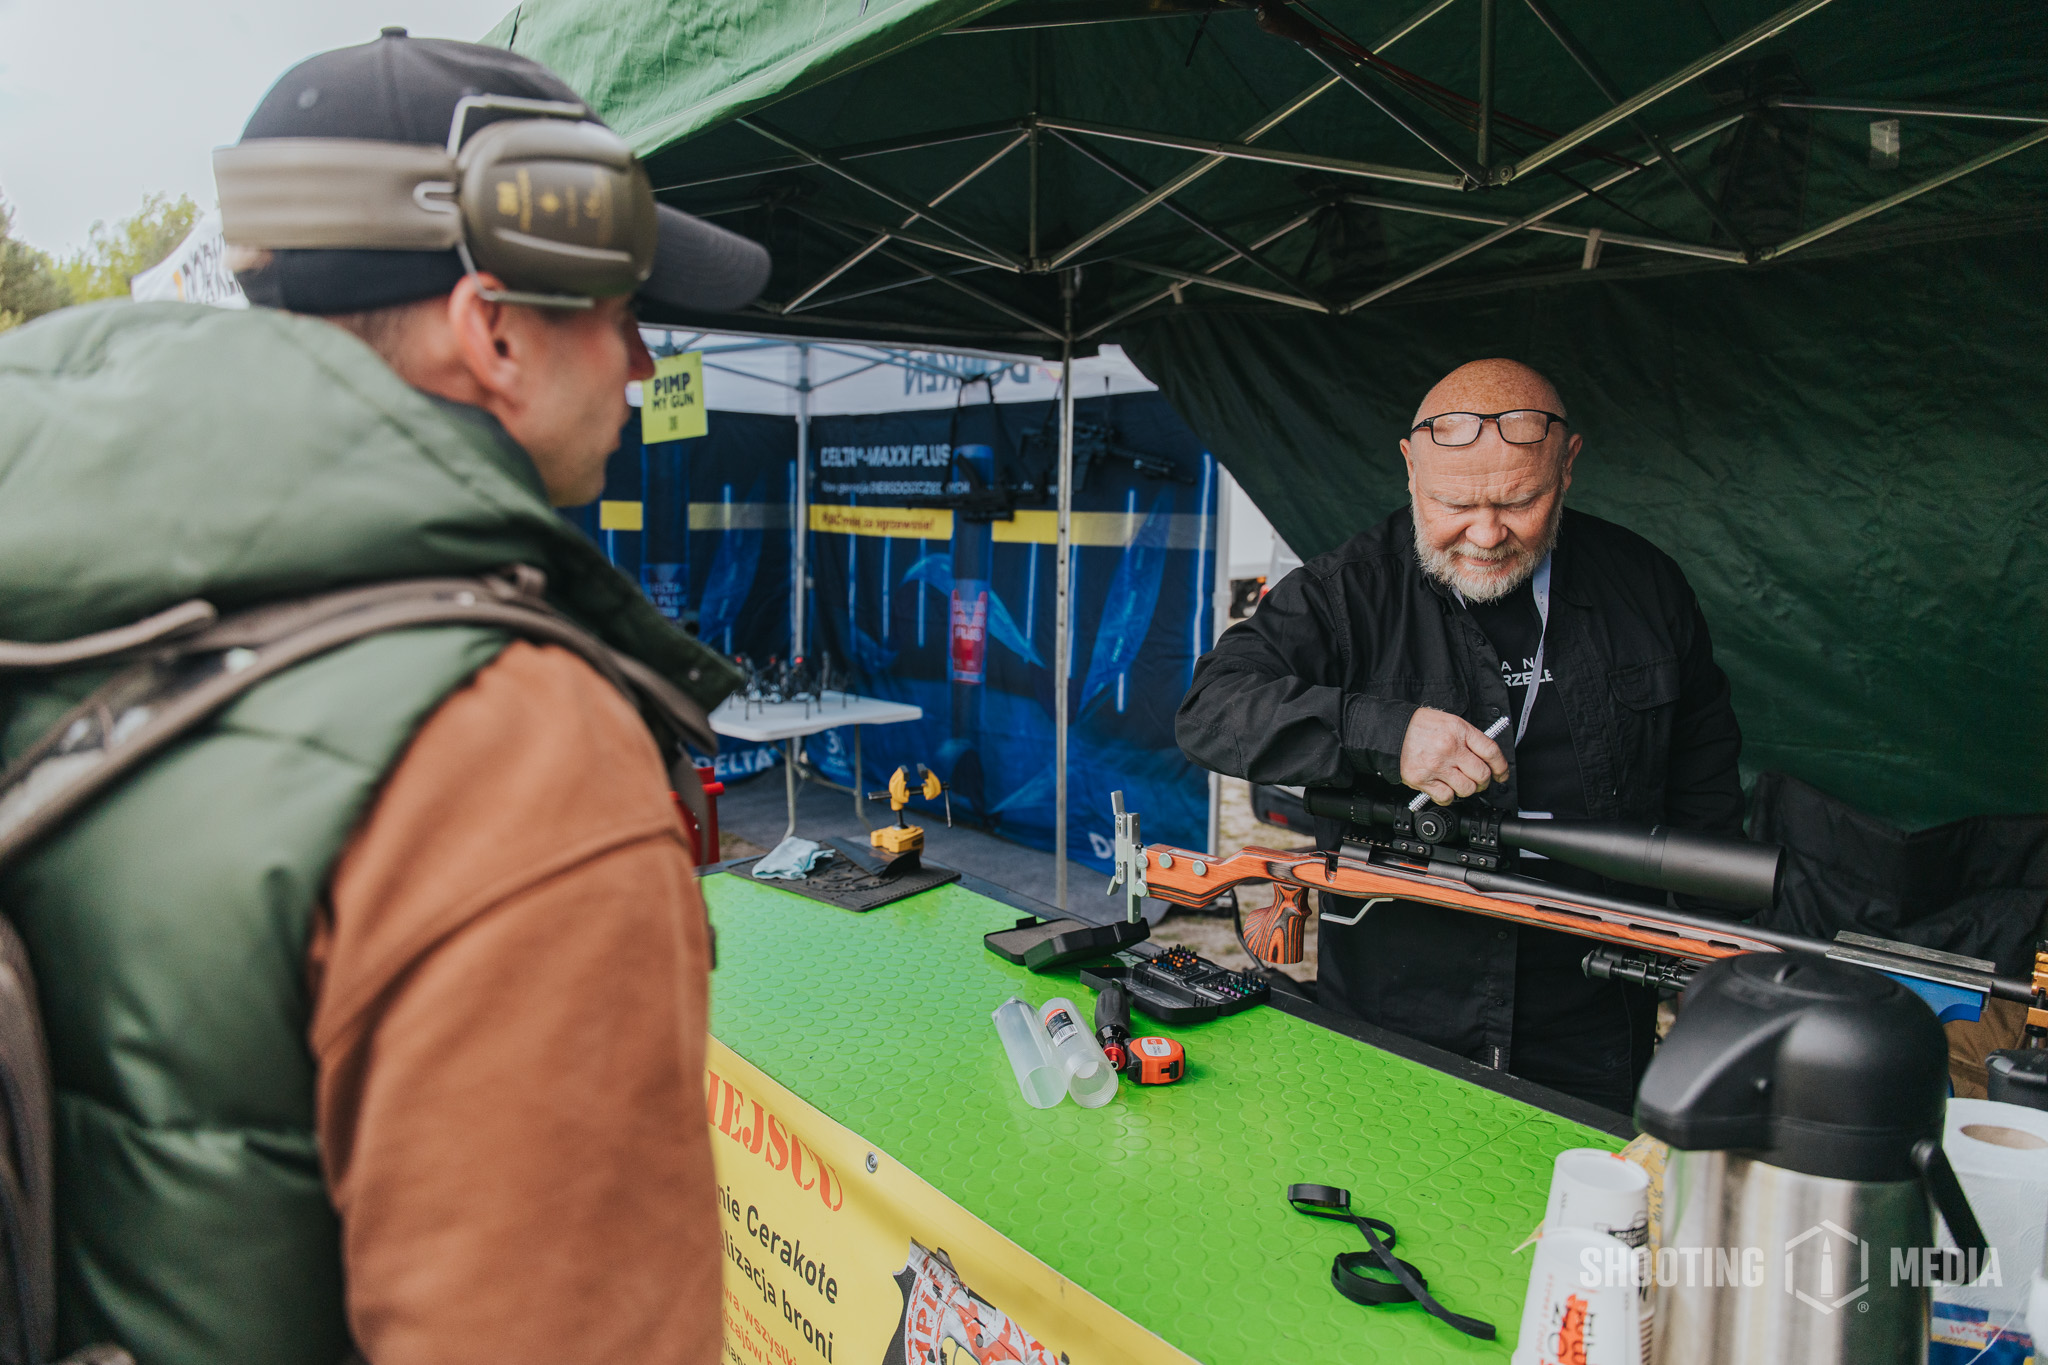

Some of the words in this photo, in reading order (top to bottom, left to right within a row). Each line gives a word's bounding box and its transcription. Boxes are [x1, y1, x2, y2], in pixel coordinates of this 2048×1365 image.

[654, 372, 690, 396] PIMP
[652, 397, 667, 411] MY
[671, 391, 695, 408] GUN
[911, 443, 951, 467] PLUS
[747, 1205, 838, 1304] Cerakote
[782, 1288, 834, 1364] broni
